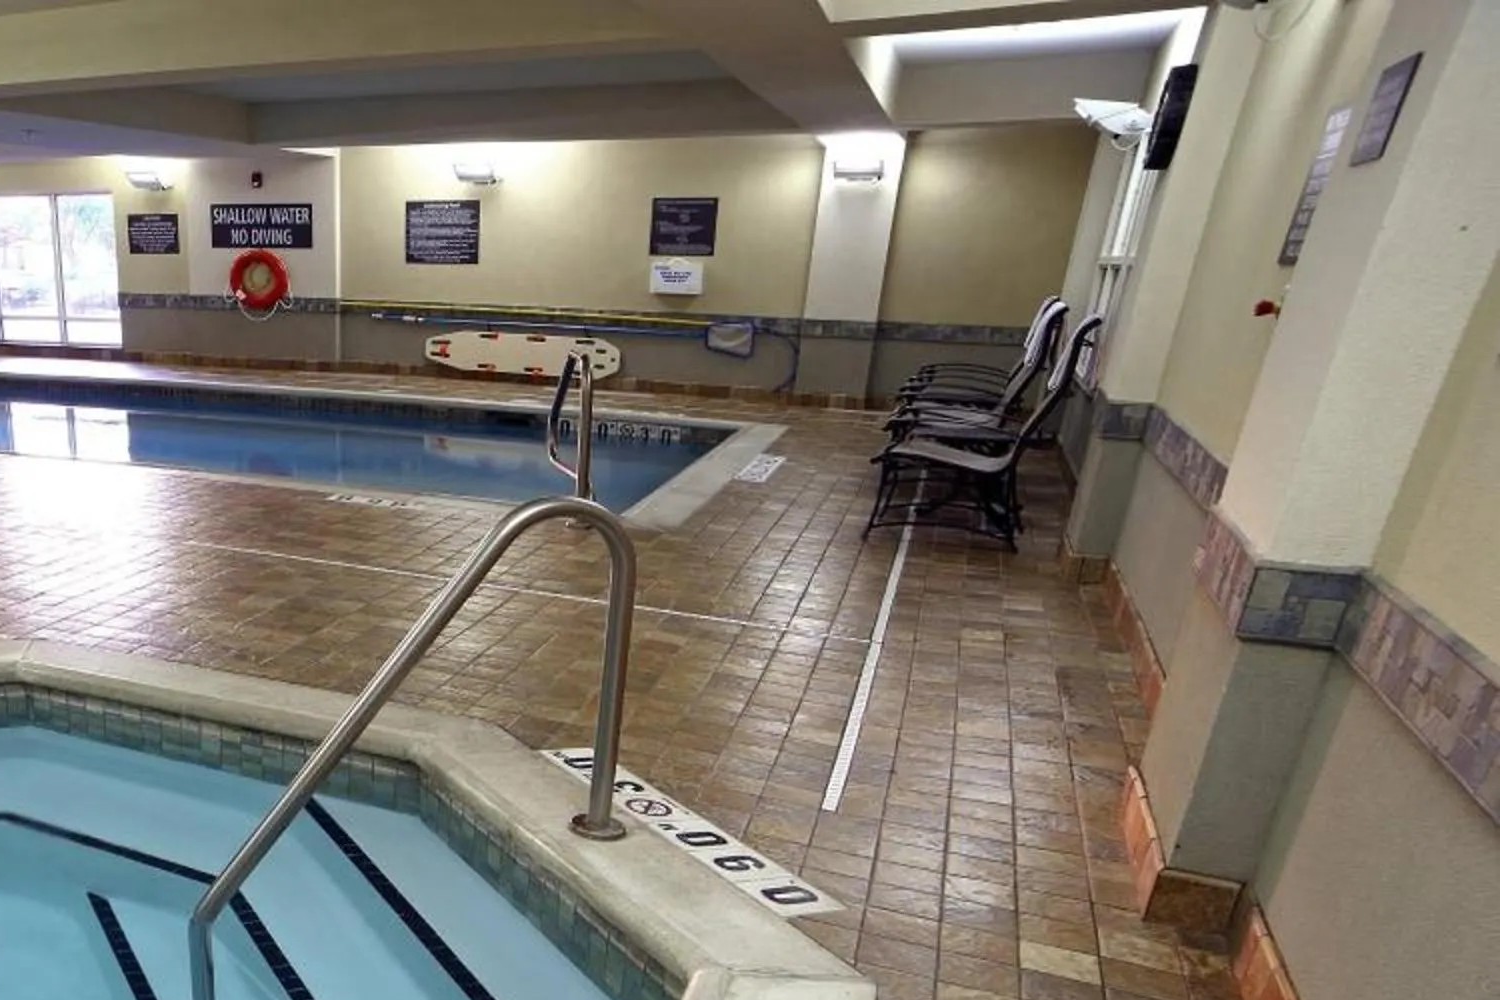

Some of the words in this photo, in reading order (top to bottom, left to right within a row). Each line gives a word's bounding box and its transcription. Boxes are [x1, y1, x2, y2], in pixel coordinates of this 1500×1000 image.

[213, 208, 267, 225] SHALLOW
[270, 208, 310, 225] WATER
[231, 229, 248, 245] NO
[251, 229, 293, 245] DIVING
